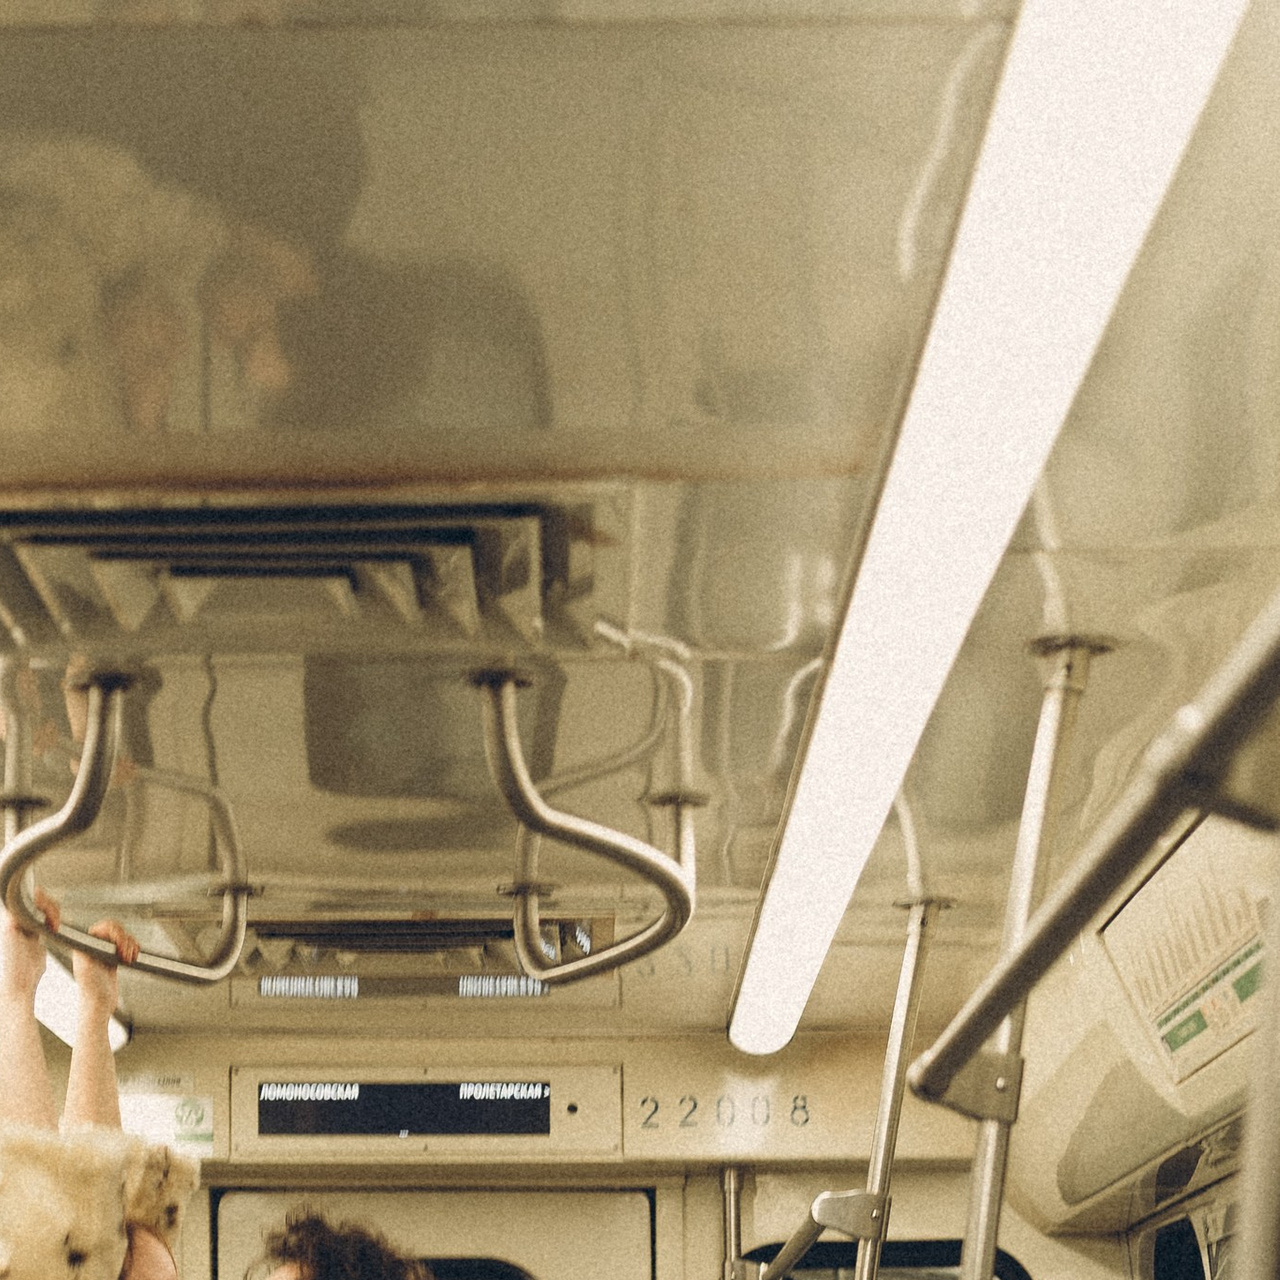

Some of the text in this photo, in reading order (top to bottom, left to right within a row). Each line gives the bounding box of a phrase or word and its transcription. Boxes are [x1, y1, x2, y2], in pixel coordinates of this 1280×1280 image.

[260, 1082, 542, 1101] ЛОМОНОСОВСКАЯ ПРОЛЕТАРСКАЯ
[640, 1094, 811, 1129] 22008
